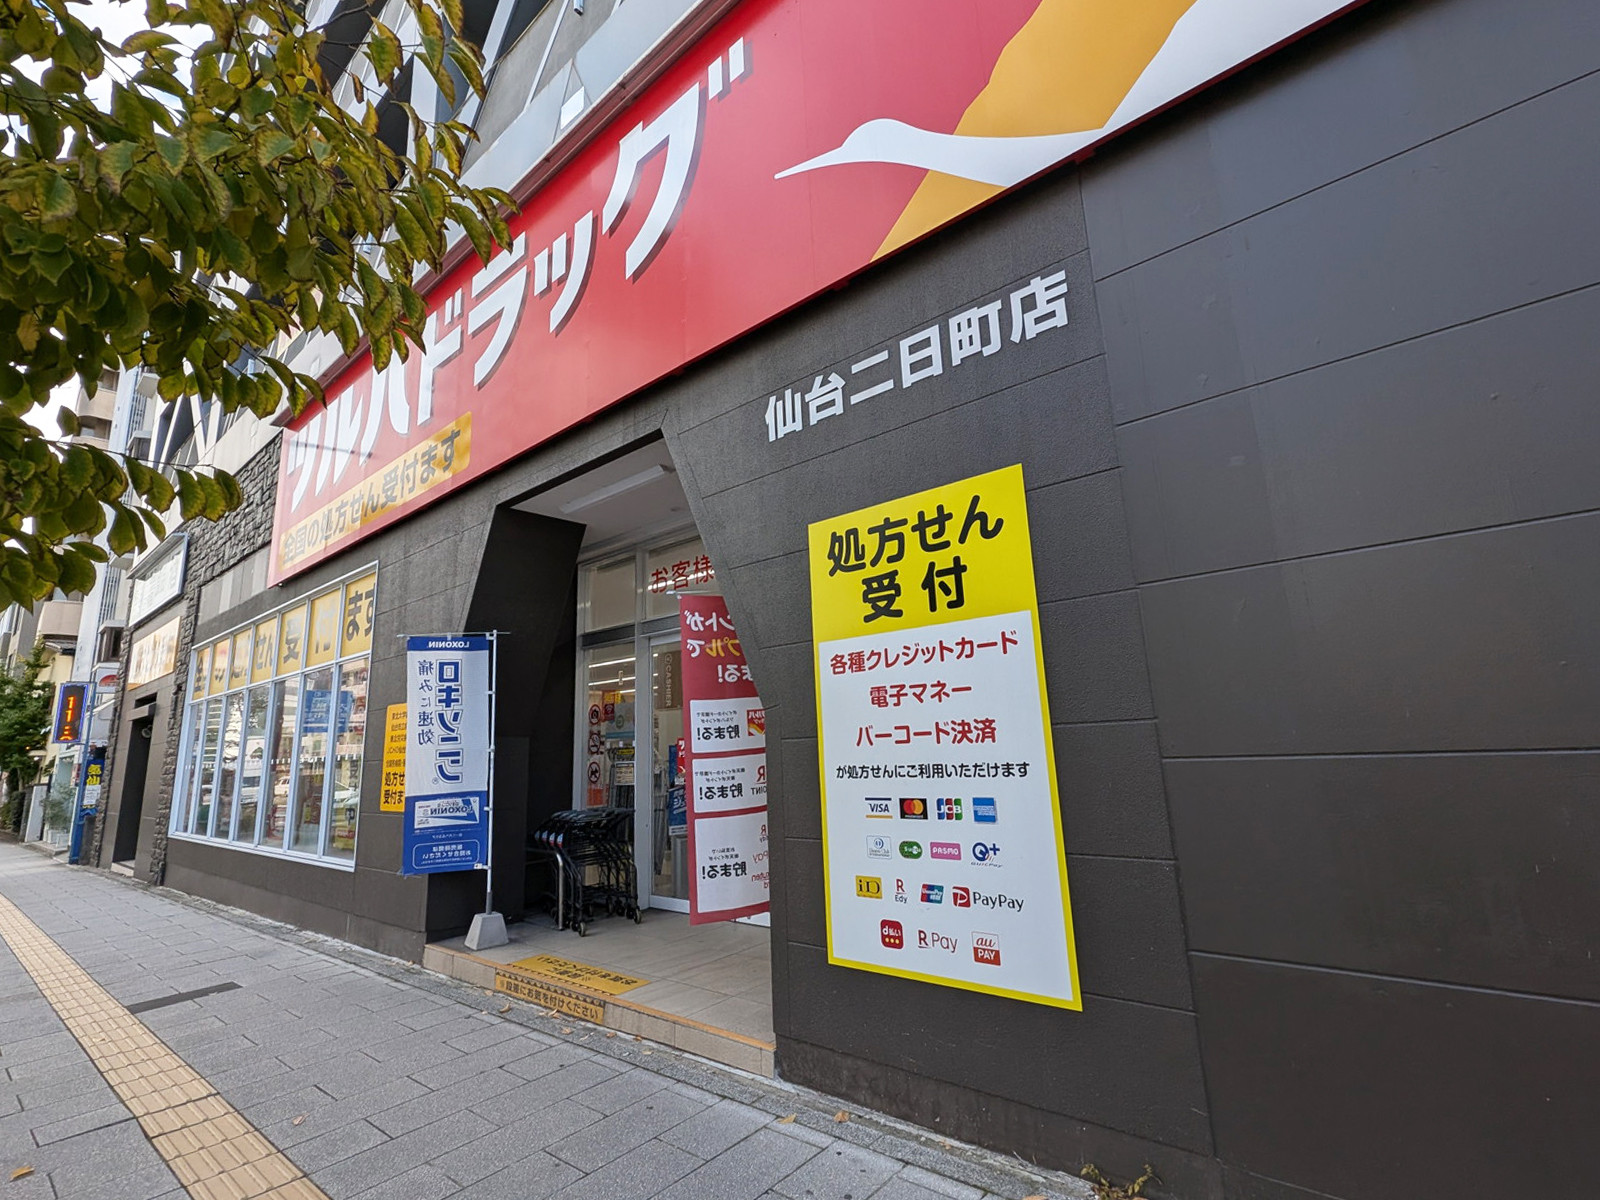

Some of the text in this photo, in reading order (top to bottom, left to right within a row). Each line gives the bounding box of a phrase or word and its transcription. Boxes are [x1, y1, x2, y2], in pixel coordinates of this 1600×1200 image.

[286, 35, 746, 513] ツルハドラッグ
[764, 269, 1068, 442] 仙台二日町店
[283, 429, 461, 564] 全国の処方せん受付ます
[827, 494, 1004, 577] 処方せん
[651, 554, 715, 594] お客様
[830, 630, 1018, 675] 各種クレジットカード
[869, 680, 972, 708] 電子マネー
[856, 717, 997, 746] バーコード決済
[836, 762, 1029, 779] が処方せんにご利用いただけます
[868, 803, 890, 813] VISA
[937, 804, 961, 813] JCB
[858, 879, 880, 895] iD
[896, 878, 905, 892] R
[894, 894, 907, 904] Edy
[972, 891, 1024, 912] PayPay
[918, 929, 958, 953] R Pay
[975, 936, 995, 947] au
[978, 950, 995, 960] PAY
